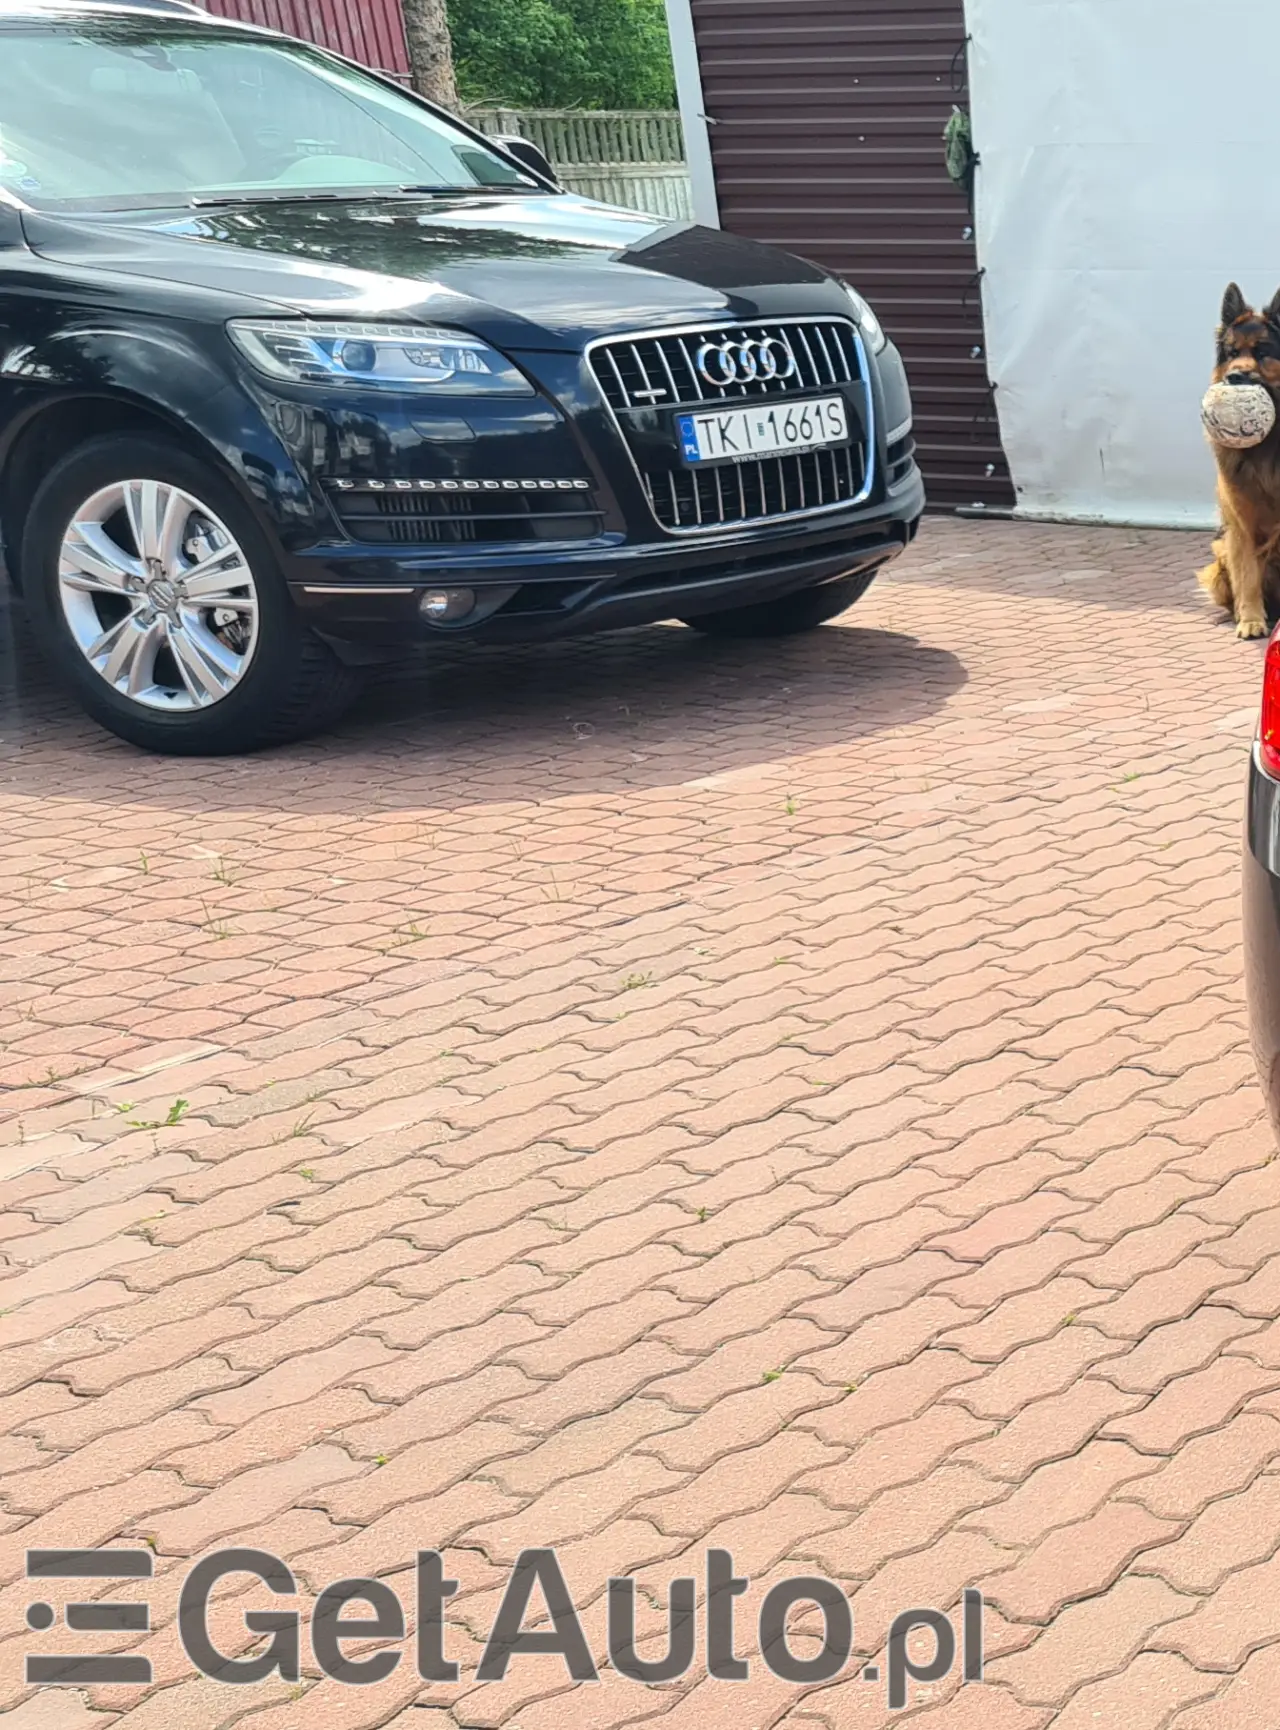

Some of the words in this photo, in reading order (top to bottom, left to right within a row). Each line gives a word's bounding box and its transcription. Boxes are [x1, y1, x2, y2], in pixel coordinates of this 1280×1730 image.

[697, 414, 753, 454] TKI
[767, 402, 843, 446] 1661S
[685, 444, 698, 455] PL
